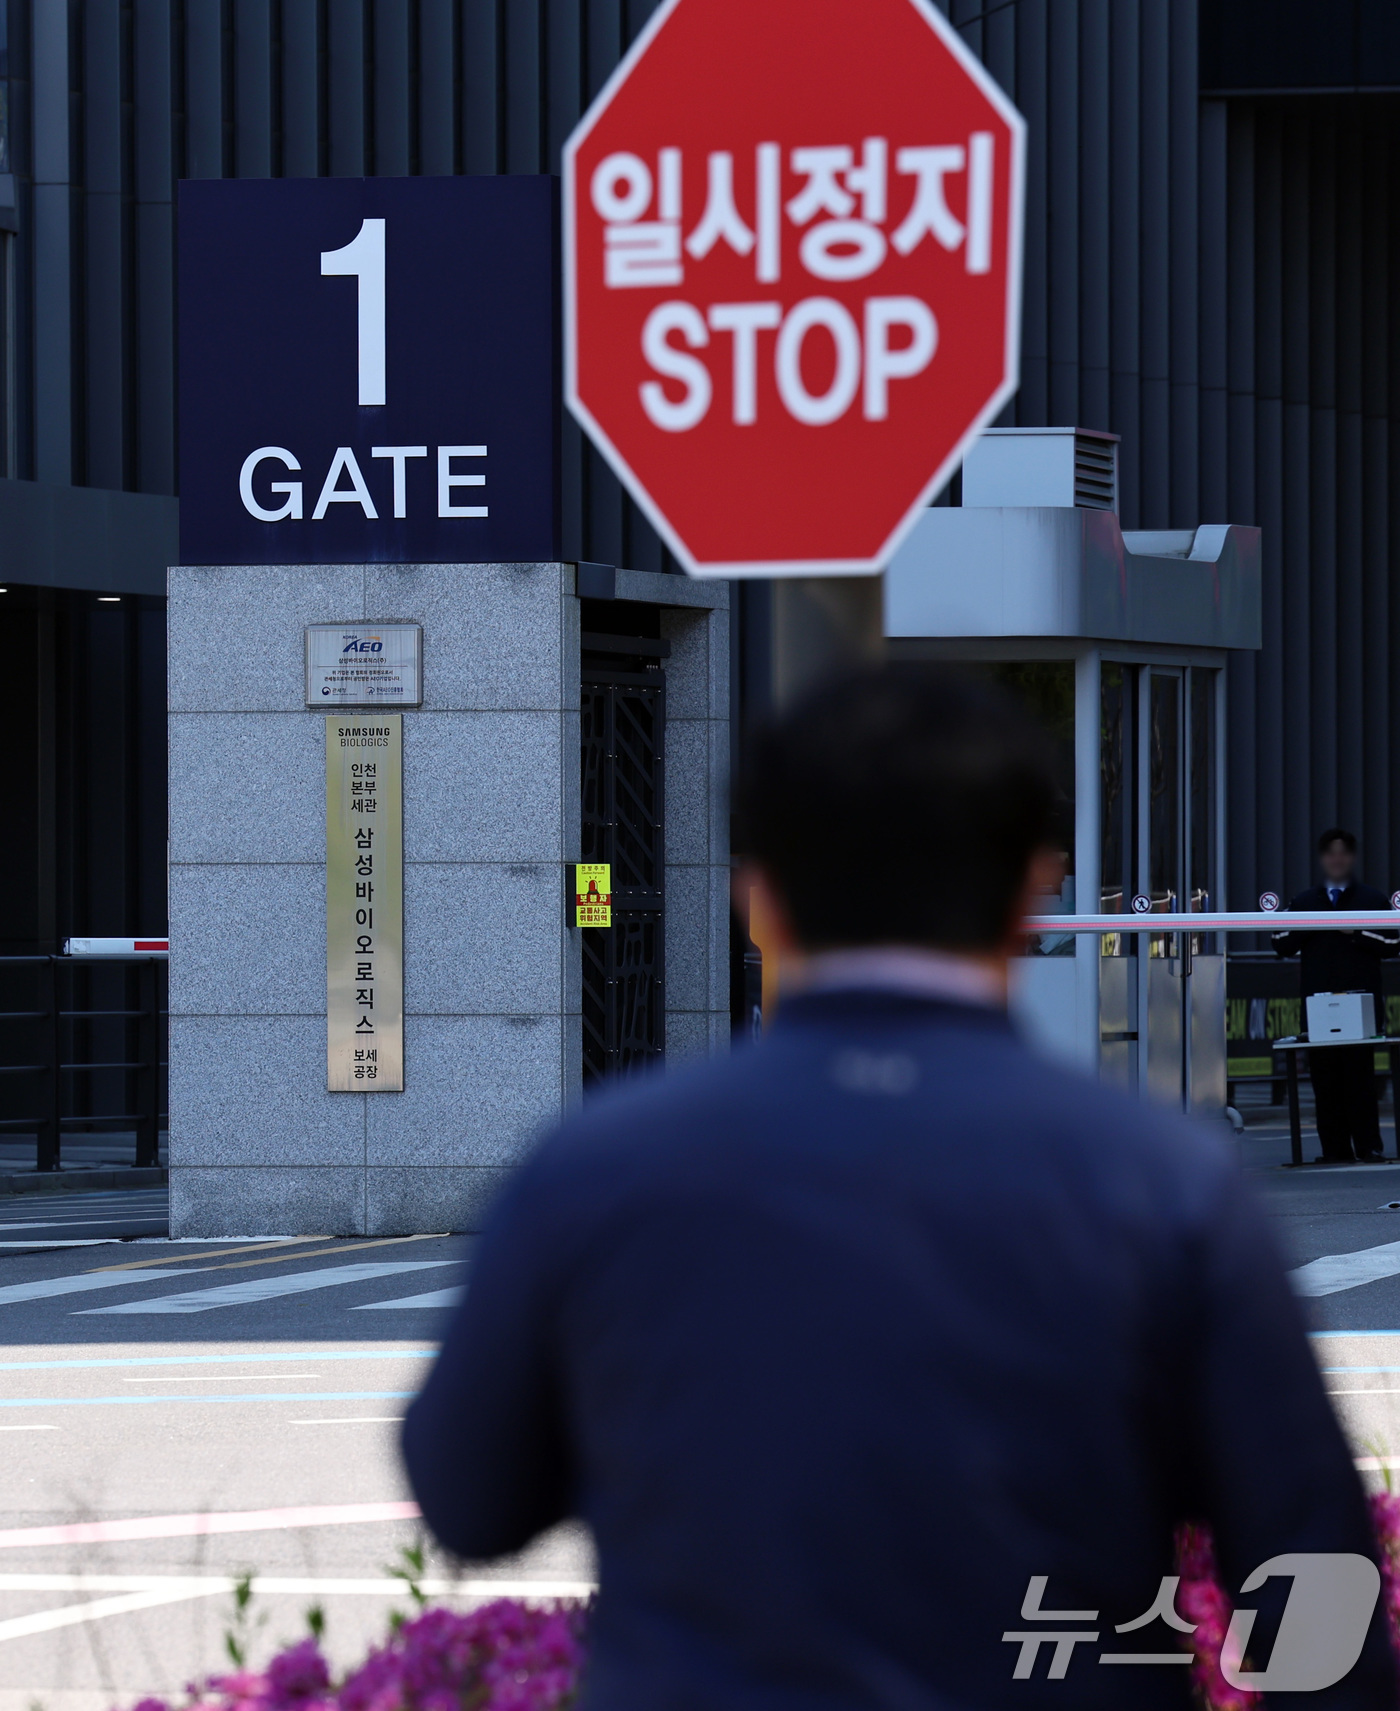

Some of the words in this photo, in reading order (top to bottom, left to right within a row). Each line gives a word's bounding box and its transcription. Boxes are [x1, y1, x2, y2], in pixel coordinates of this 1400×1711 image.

[590, 131, 994, 289] 일시정지
[320, 218, 386, 406] 1
[639, 296, 939, 432] STOP
[239, 445, 489, 522] GATE
[342, 638, 383, 653] AEO
[338, 727, 390, 737] SAMSUNG
[340, 738, 389, 747] BIOLOGICS
[351, 763, 377, 778] 인천
[351, 780, 377, 795] 본부
[351, 798, 377, 813] 세관
[580, 894, 608, 903] 보행자
[354, 827, 374, 1034] 삼성바이오로직스
[353, 1049, 378, 1062] 보세
[353, 1065, 378, 1079] 공장
